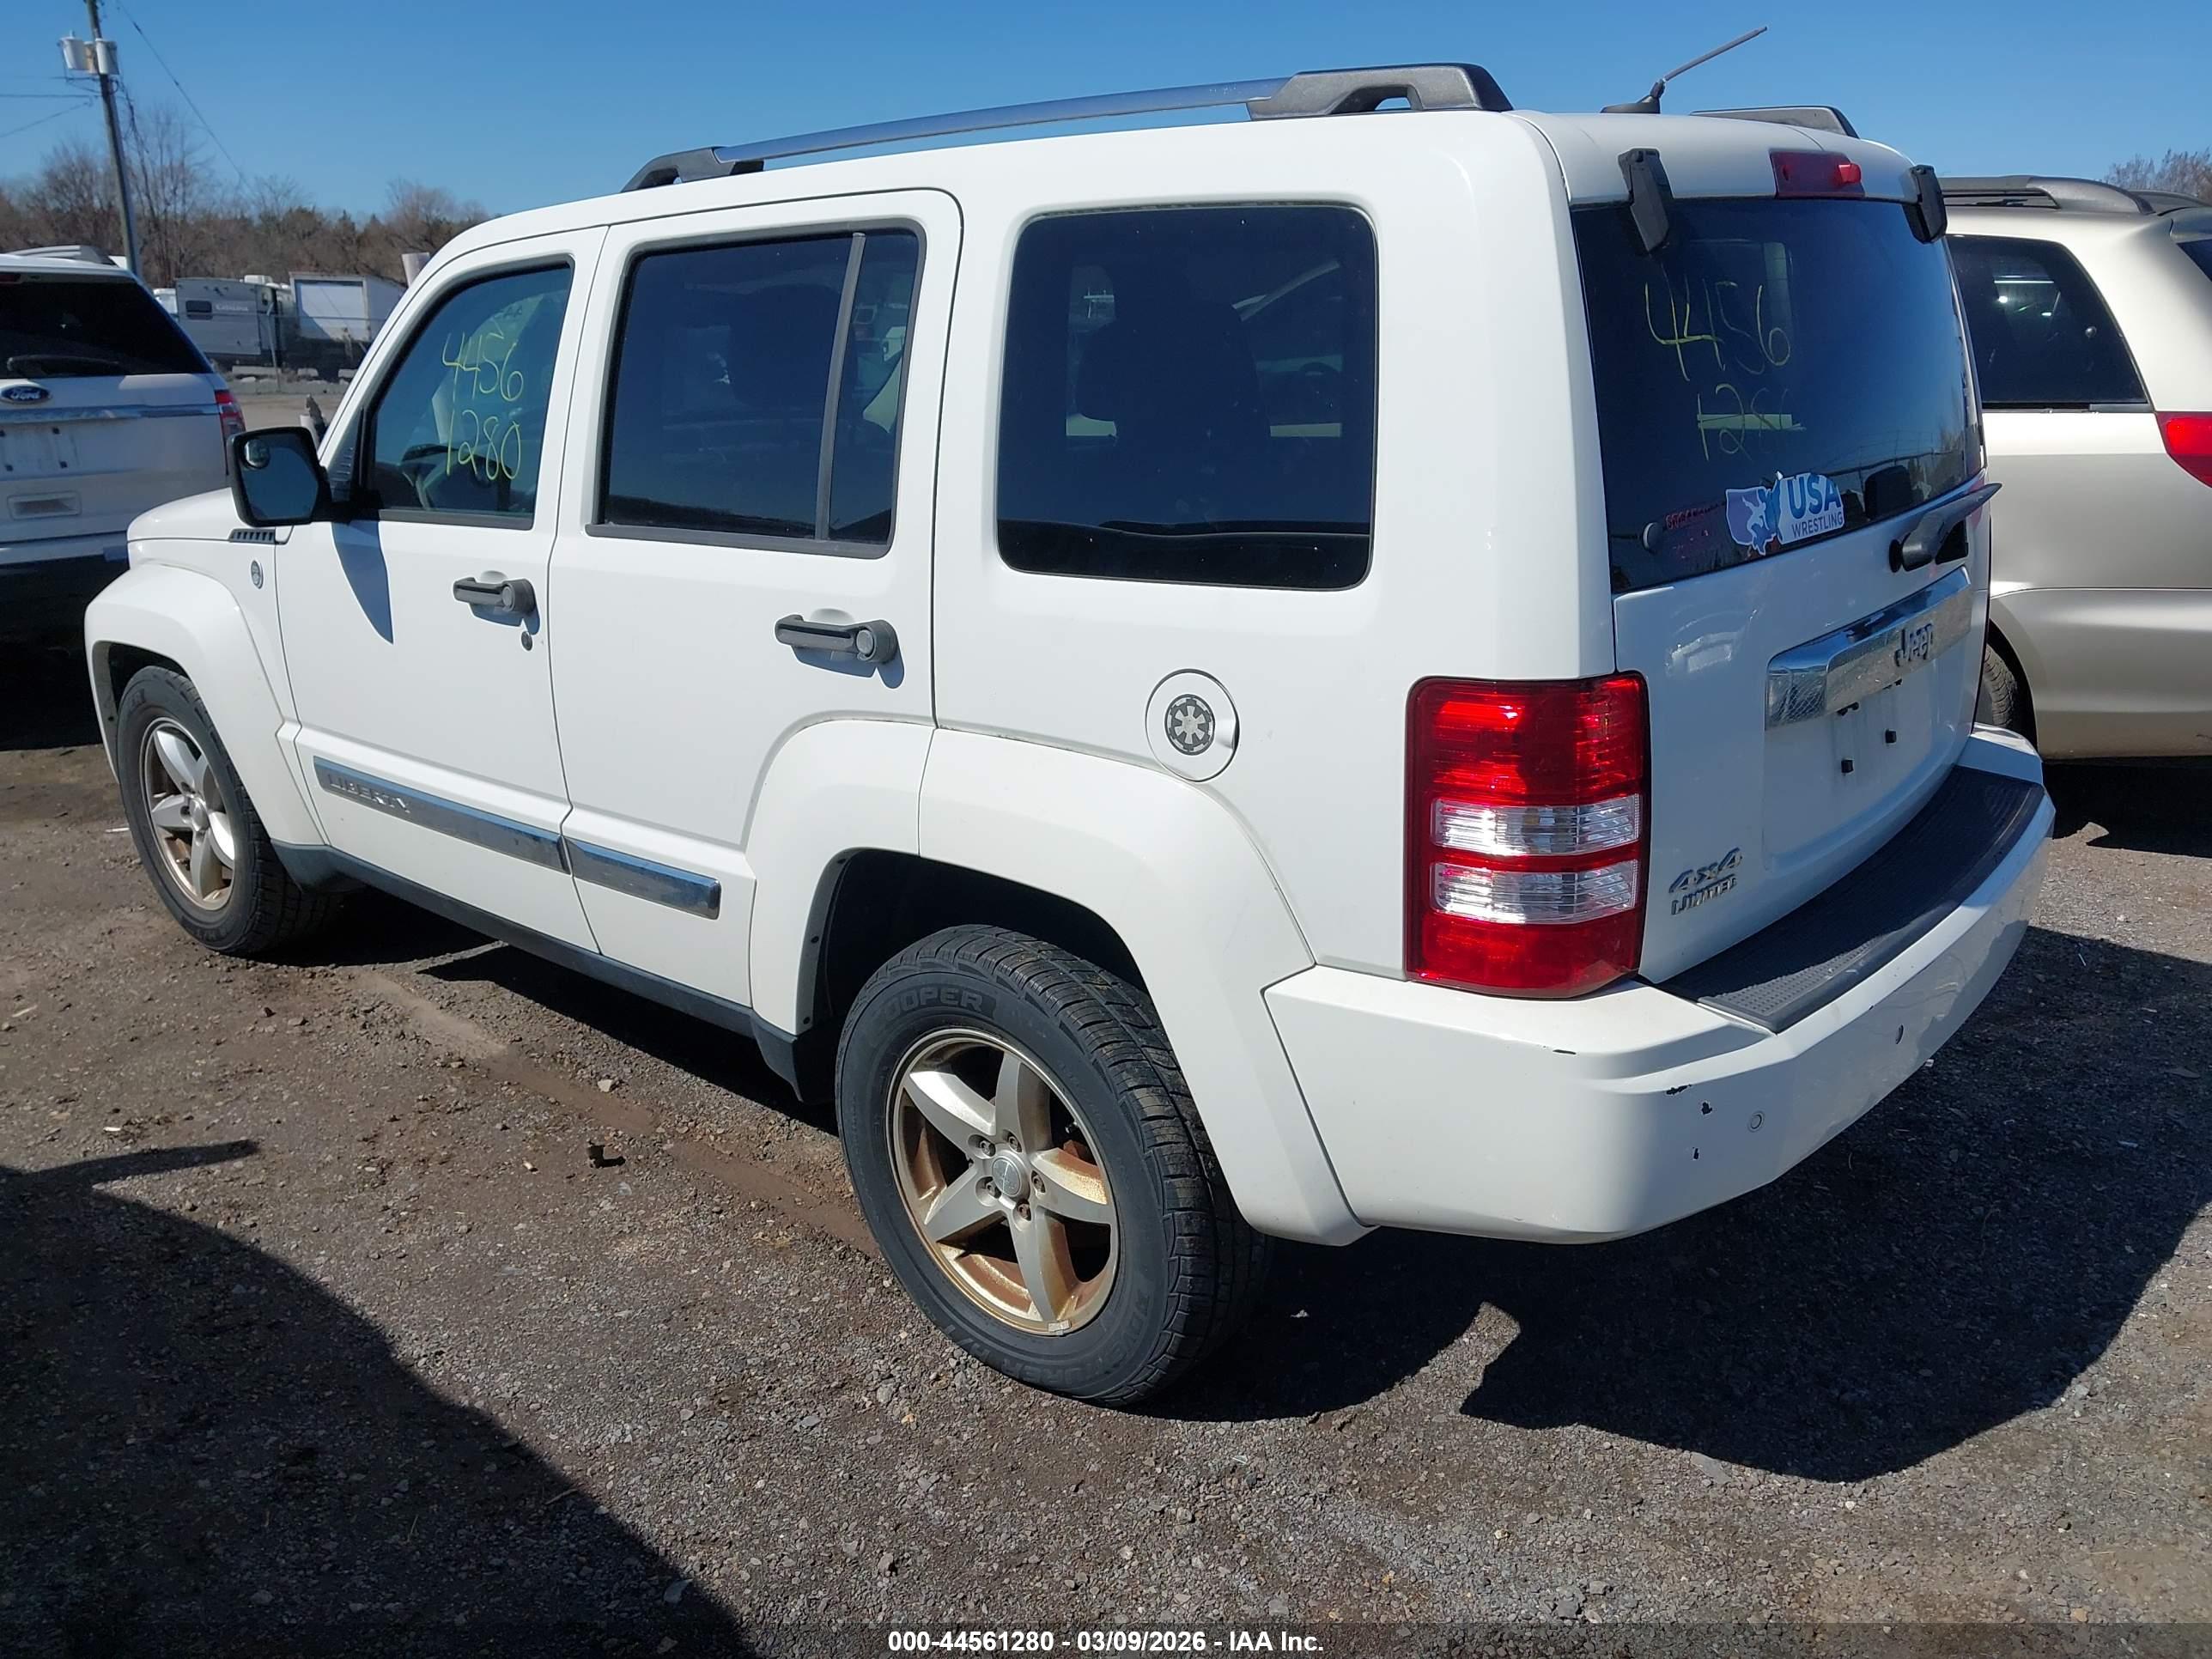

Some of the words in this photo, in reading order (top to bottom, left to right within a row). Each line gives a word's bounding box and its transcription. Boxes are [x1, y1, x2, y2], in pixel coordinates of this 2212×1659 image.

[1644, 268, 1790, 381] 4456
[442, 331, 524, 402] 4456
[446, 409, 521, 480] 1280
[1788, 473, 1842, 520] USA
[1792, 511, 1844, 539] WRESTLING
[1894, 623, 1934, 666] Jeep
[871, 988, 983, 1022] OOPER
